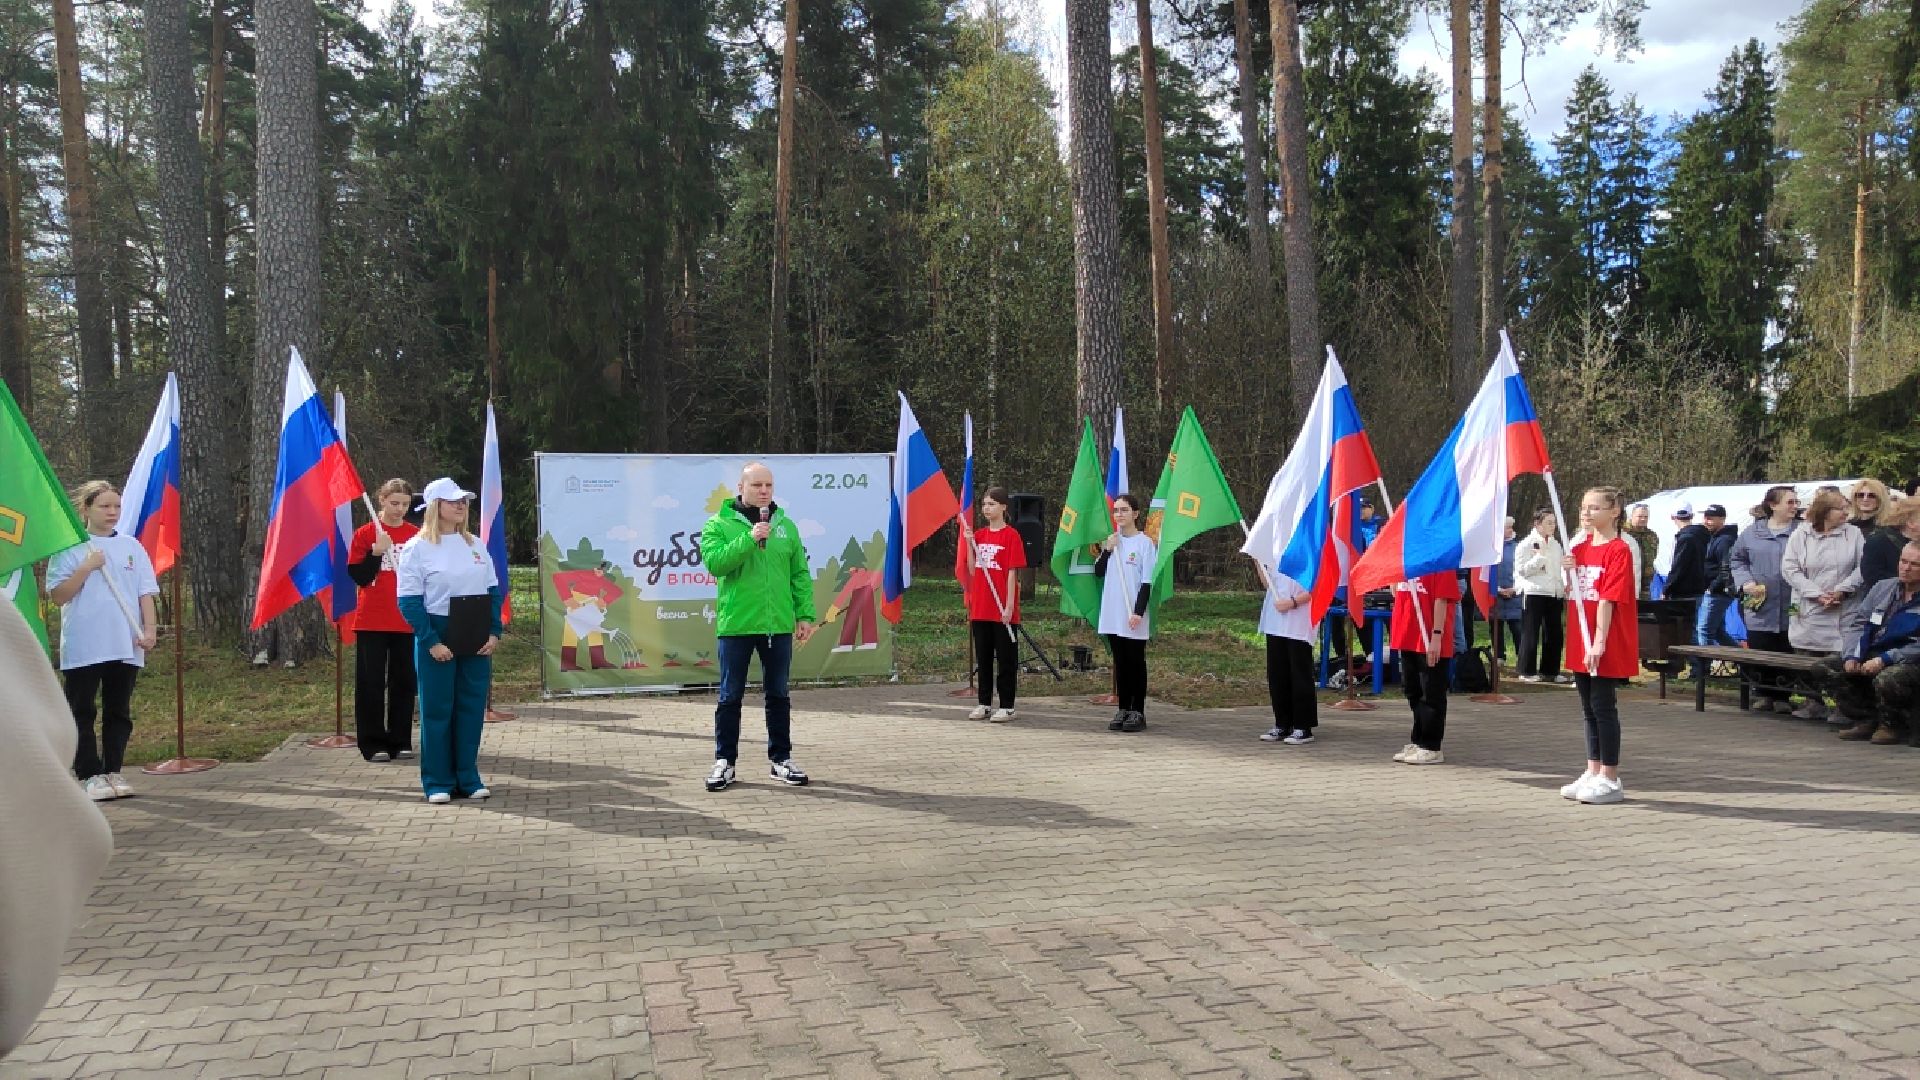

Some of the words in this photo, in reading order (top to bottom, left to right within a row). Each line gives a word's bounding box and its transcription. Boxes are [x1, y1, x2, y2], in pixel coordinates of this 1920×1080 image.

[812, 473, 868, 489] 22.04
[633, 531, 703, 585] субб
[682, 573, 718, 585] под
